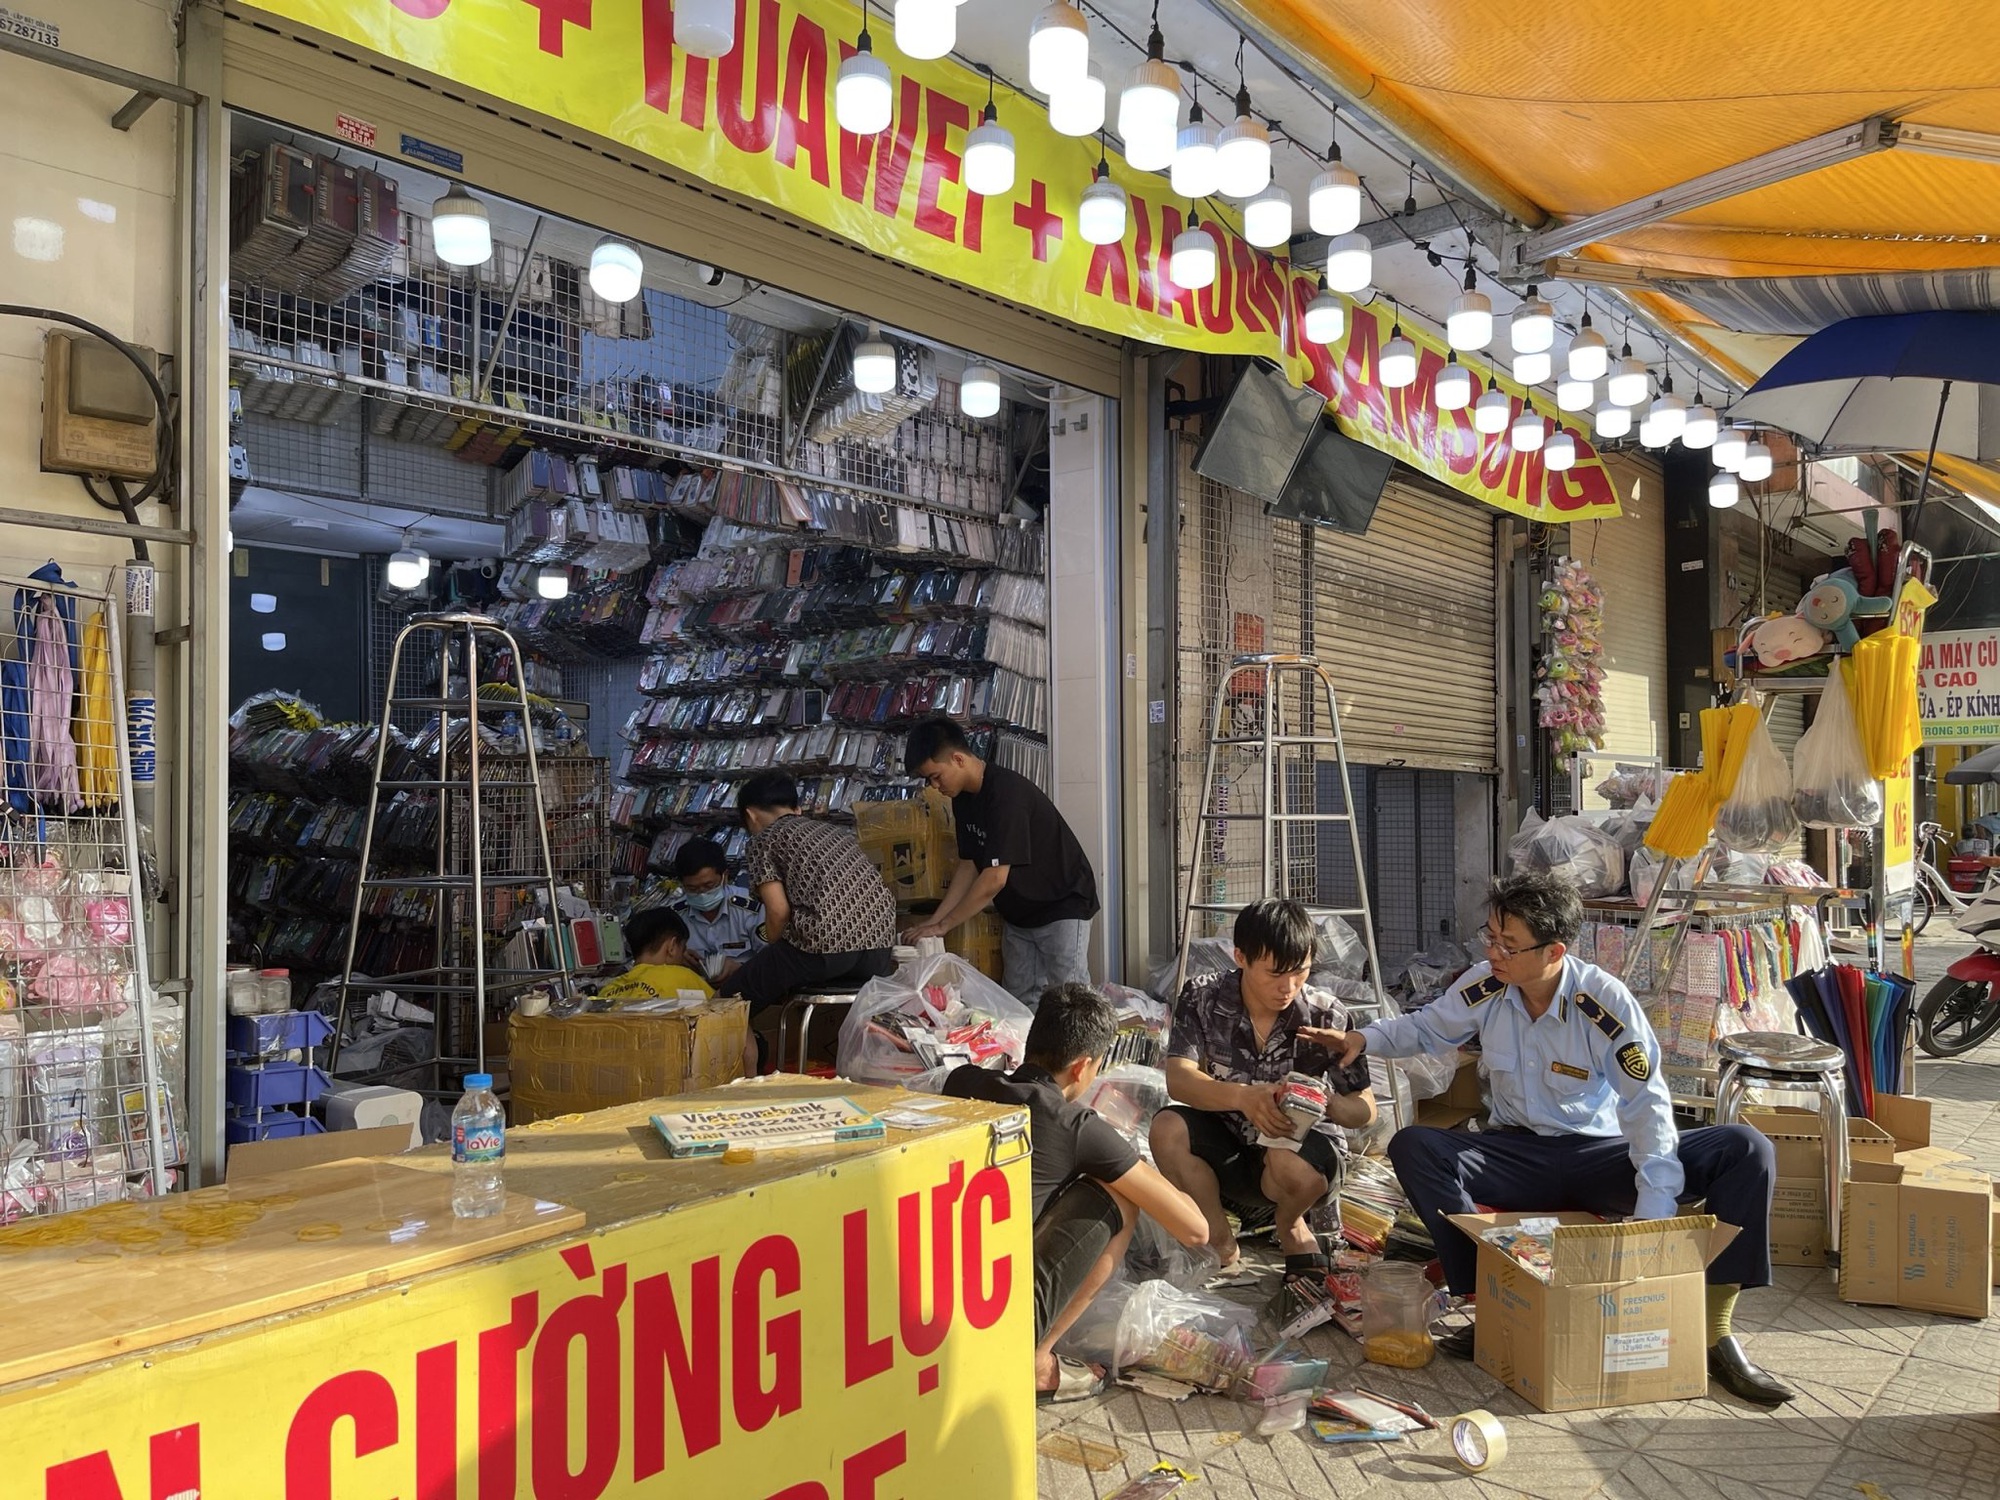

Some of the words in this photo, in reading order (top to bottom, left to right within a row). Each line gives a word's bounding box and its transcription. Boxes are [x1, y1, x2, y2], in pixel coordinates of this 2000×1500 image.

[1918, 645, 1935, 670] UA
[1939, 637, 1973, 670] MÁY
[1977, 635, 1998, 668] CŨ
[1934, 671, 1977, 688] CAO
[1947, 690, 1963, 719] ÉP
[1966, 688, 2000, 718] KÍNH
[1956, 726, 1969, 735] 30
[682, 1102, 826, 1124] Vietcombank
[1623, 1293, 1666, 1305] FRESENIUS
[1623, 1306, 1642, 1316] KABI
[286, 1234, 802, 1500] CƯỜNG
[843, 1160, 1012, 1396] LỰC
